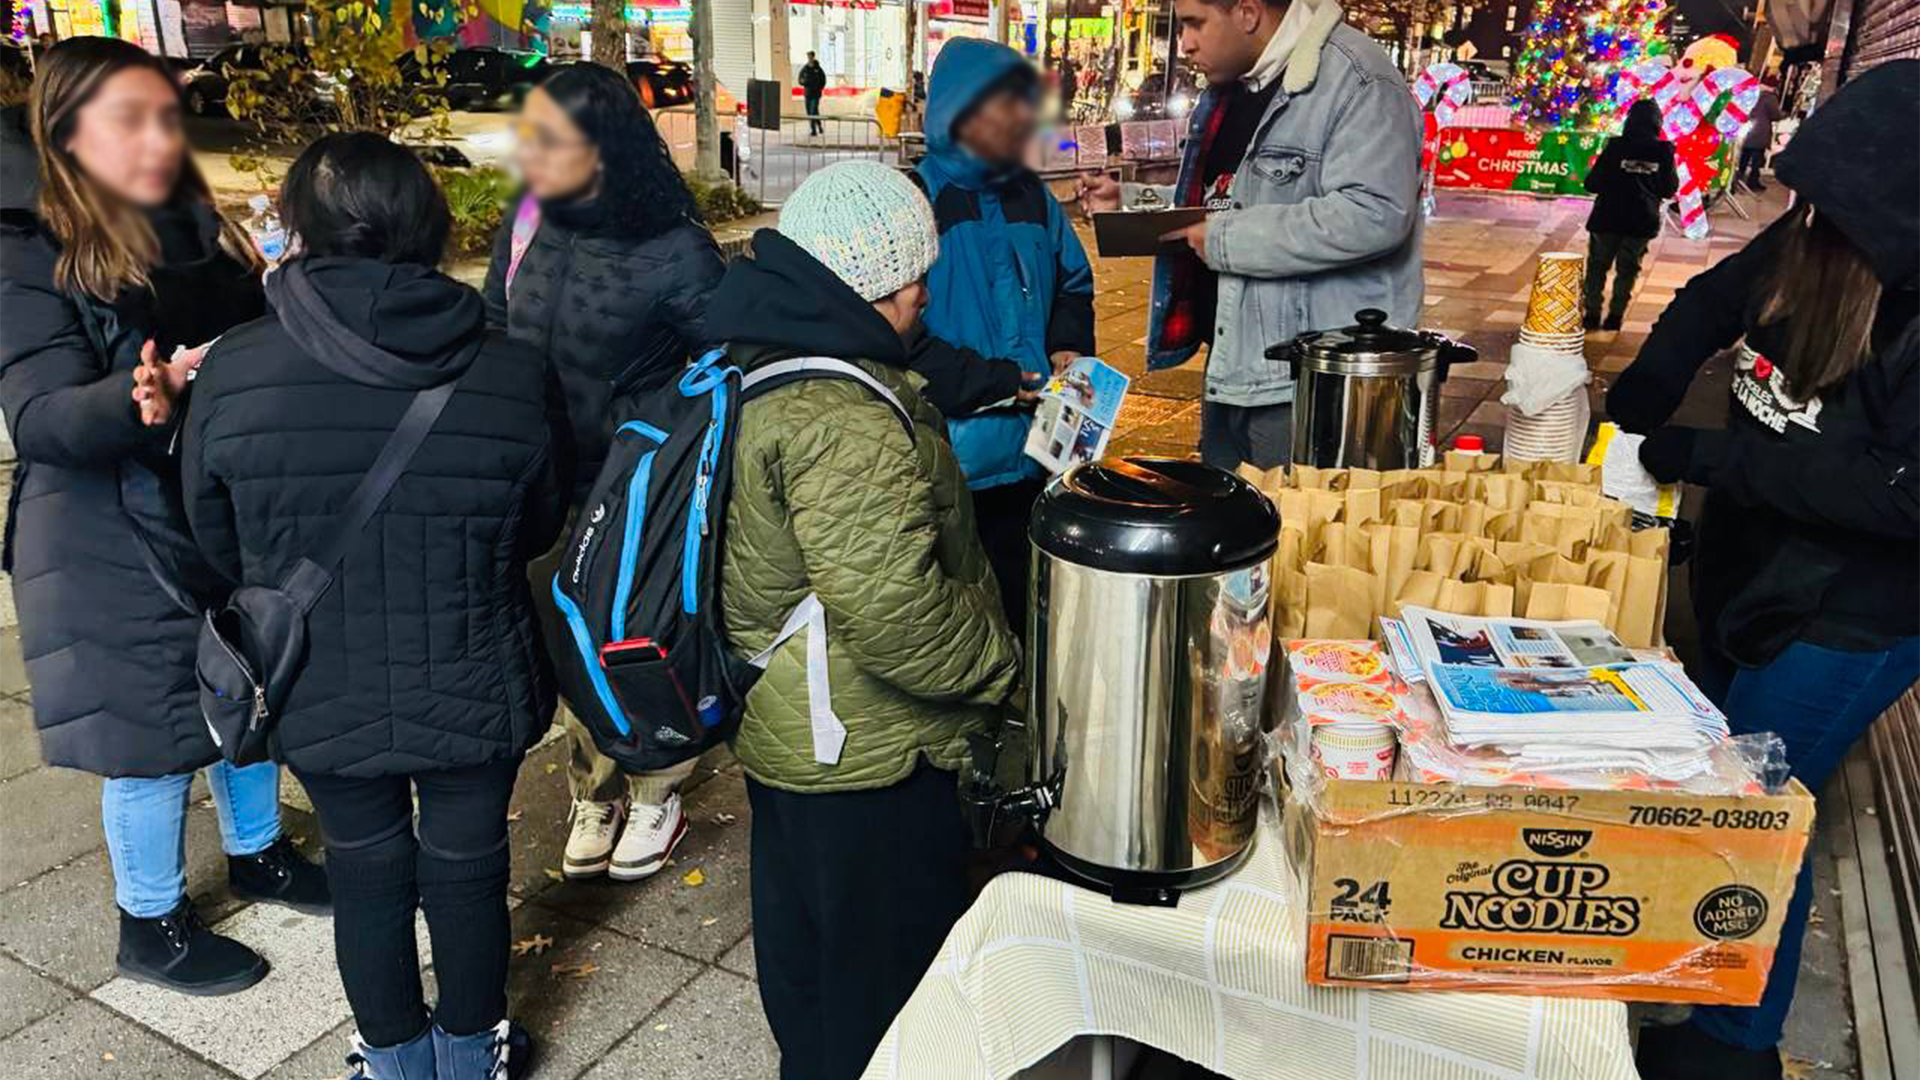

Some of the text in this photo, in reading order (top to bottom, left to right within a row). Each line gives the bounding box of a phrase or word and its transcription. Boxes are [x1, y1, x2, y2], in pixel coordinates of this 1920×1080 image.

[1506, 149, 1543, 160] MERRY
[1478, 158, 1568, 176] CHRISTMAS
[1628, 806, 1789, 831] 70662-03803
[1529, 831, 1584, 849] NISSIN
[1446, 863, 1493, 884] Original
[1494, 860, 1609, 898] CUP
[1331, 878, 1392, 910] 24
[1718, 895, 1744, 909] NO
[1330, 907, 1390, 924] PACK
[1441, 892, 1640, 935] NOODLES
[1704, 905, 1759, 922] ADDED
[1713, 920, 1749, 933] MSG
[1461, 947, 1613, 966] CHICKEN FLAVOR
